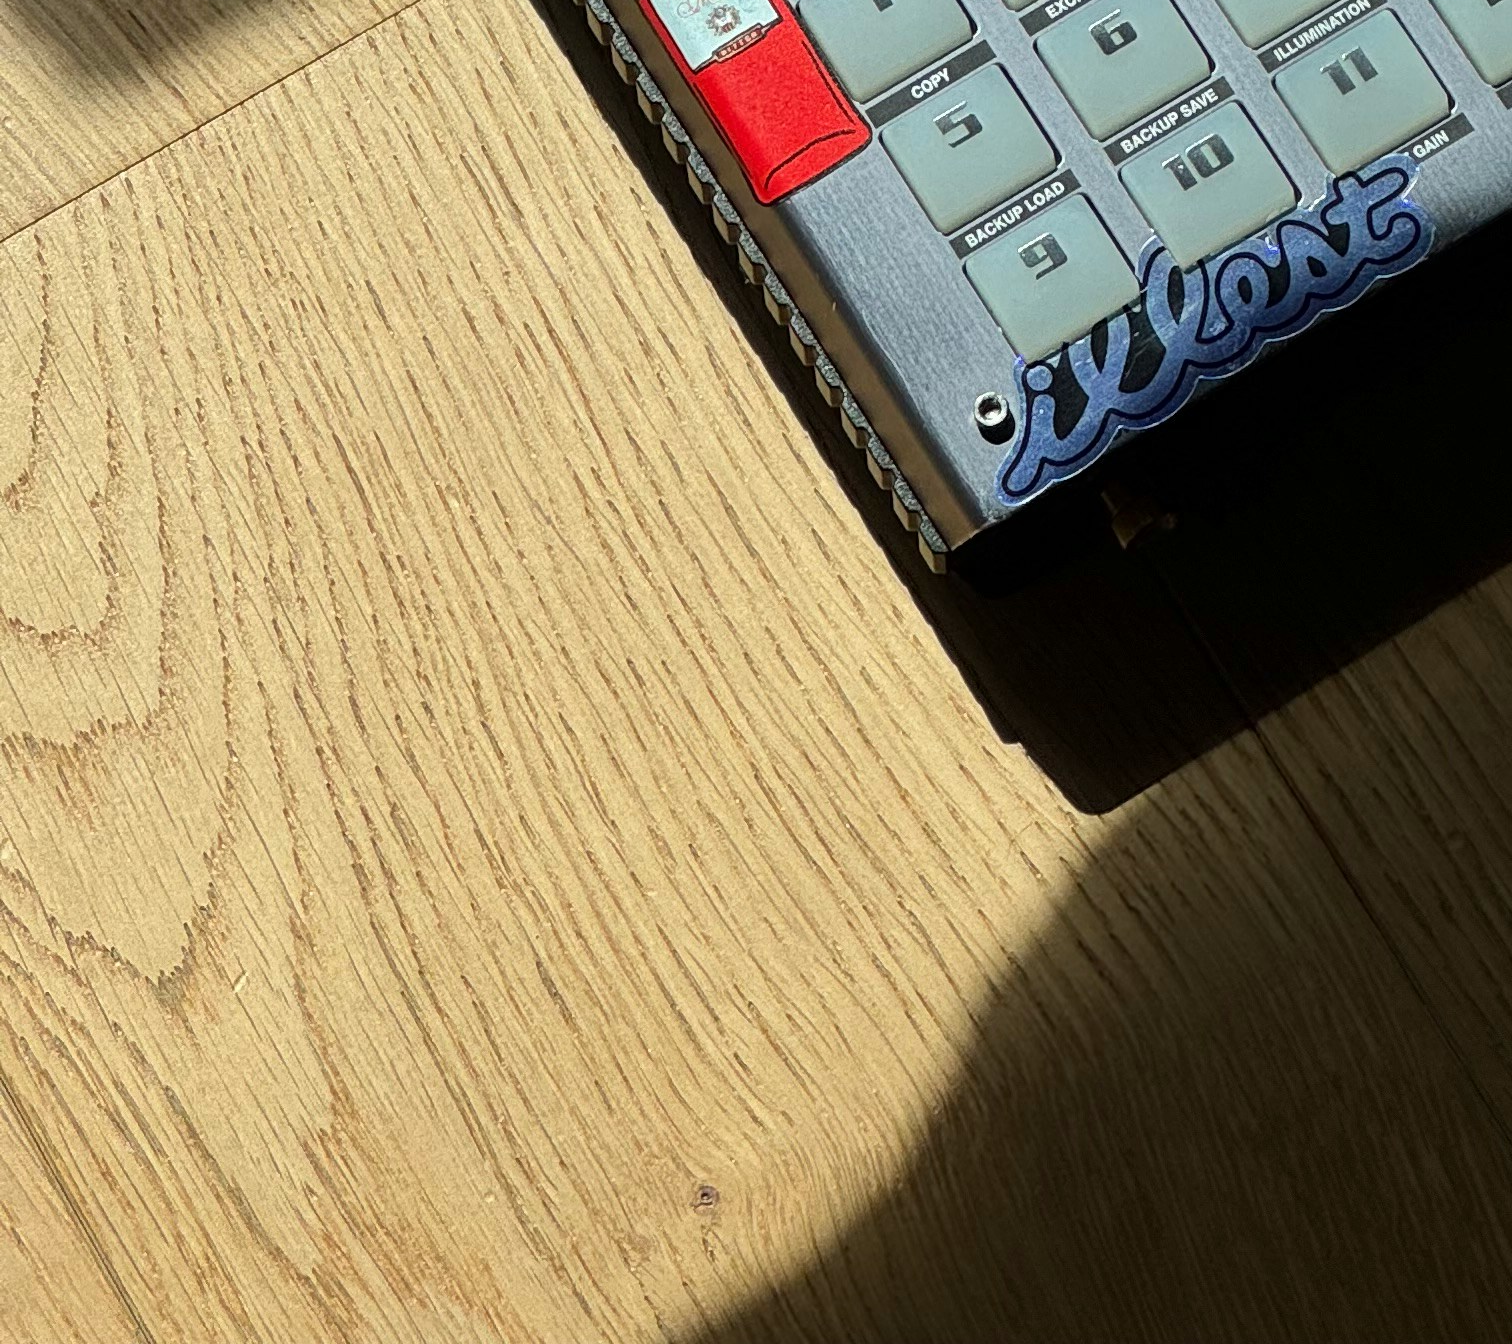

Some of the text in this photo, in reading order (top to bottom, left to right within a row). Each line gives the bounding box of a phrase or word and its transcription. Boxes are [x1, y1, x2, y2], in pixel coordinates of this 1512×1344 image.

[908, 67, 954, 101] COPY
[1318, 44, 1379, 99] 11
[1160, 129, 1236, 194] 10
[963, 179, 1067, 249] BACKUP LOAD
[1018, 231, 1067, 278] 9
